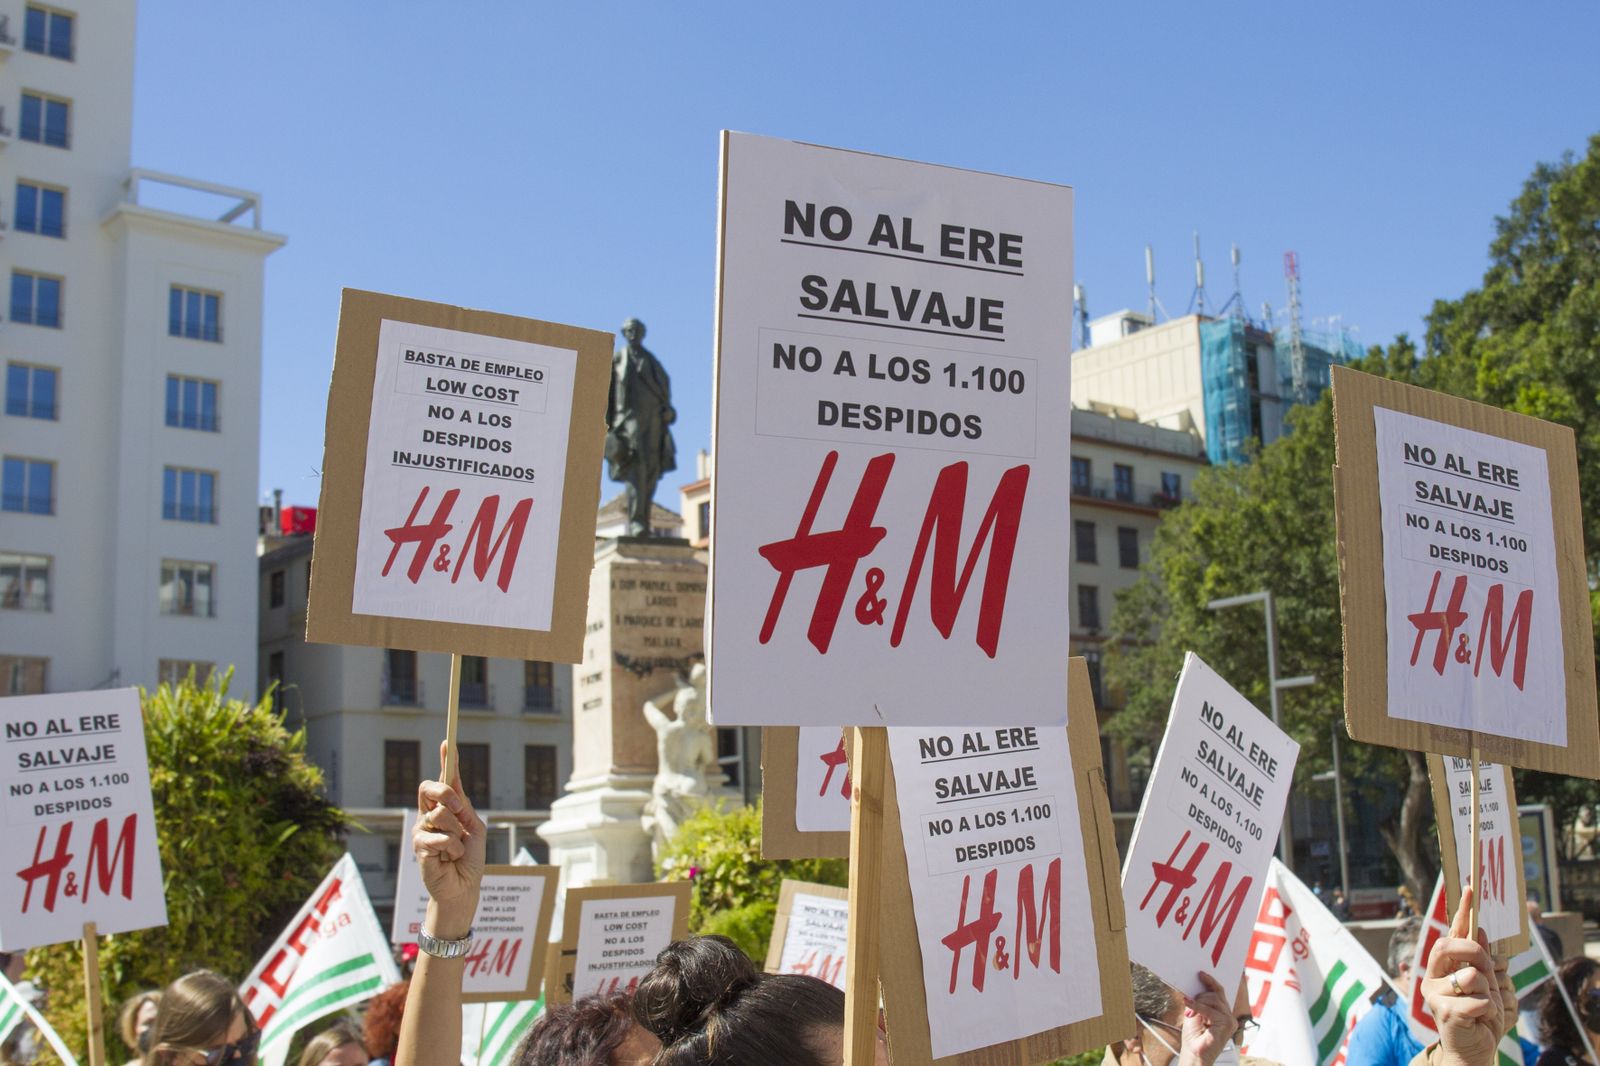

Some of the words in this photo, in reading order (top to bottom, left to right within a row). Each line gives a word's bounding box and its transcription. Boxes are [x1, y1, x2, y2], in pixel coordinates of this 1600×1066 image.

[784, 200, 853, 242] NO
[867, 214, 924, 254] AL
[940, 223, 1023, 268] ERE
[800, 275, 1004, 334] SALVAJE
[405, 350, 456, 368] BASTA
[461, 358, 480, 371] DE
[484, 362, 544, 381] EMPLEO
[772, 343, 822, 373] NO
[832, 351, 857, 377] A
[868, 354, 931, 384] LOS
[943, 363, 1025, 395] 1.100
[426, 377, 467, 396] LOW
[472, 384, 519, 403] COST
[428, 405, 455, 421] NO
[459, 411, 472, 424] A
[477, 412, 512, 429] LOS
[817, 400, 982, 440] DESPIDOS
[422, 430, 512, 454] DESPIDOS
[393, 451, 535, 480] INJUSTIFICADOS
[1404, 443, 1436, 466] NO
[1444, 454, 1471, 475] AL
[1478, 461, 1519, 487] ERE
[1415, 480, 1514, 520] SALVAJE
[381, 486, 534, 594] H&M
[1406, 513, 1430, 531] NO
[1434, 520, 1446, 534] A
[1450, 523, 1481, 542] LOS
[1486, 531, 1527, 553] 1.100
[758, 450, 1030, 659] H&M
[1429, 544, 1509, 574] DESPIDOS
[1407, 570, 1533, 691] H&M
[6, 720, 38, 738] NO
[45, 718, 73, 734] AL
[79, 714, 121, 731] ERE
[1201, 700, 1224, 731] NO
[1226, 725, 1245, 752] AL
[1249, 742, 1278, 779] ERE
[18, 745, 116, 768] SALVAJE
[919, 736, 954, 759] NO
[962, 732, 990, 754] AL
[995, 727, 1038, 749] ERE
[10, 783, 33, 797] NO
[39, 780, 50, 793] A
[54, 777, 85, 792] LOS
[90, 773, 130, 789] 1.100
[935, 766, 1036, 799] SALVAJE
[1197, 740, 1264, 807] SALVAJE
[1459, 778, 1492, 795] SAAJE
[34, 797, 112, 816] DESPIDOS
[928, 819, 953, 836] NO
[959, 816, 971, 832] A
[974, 811, 1006, 830] LOS
[1011, 804, 1051, 823] 1.100
[1181, 767, 1198, 788] NO
[1200, 781, 1208, 796] A
[1210, 789, 1233, 816] LOS
[1235, 811, 1262, 841] 1.100
[1458, 806, 1468, 816] NO
[1484, 801, 1499, 813] 1.100
[1188, 803, 1243, 855] DESPIDOS
[1468, 820, 1494, 834] DIDOS
[16, 813, 137, 913] H&M
[955, 836, 1036, 863] DESPIDOS
[632, 909, 660, 917] EMPLEO
[1140, 830, 1252, 968] H&M
[625, 922, 648, 930] COST
[941, 857, 1061, 994] H&M
[464, 938, 522, 978] H&M
[588, 960, 656, 971] INJUSTIFICADOS
[602, 948, 645, 957] DESPIDOS
